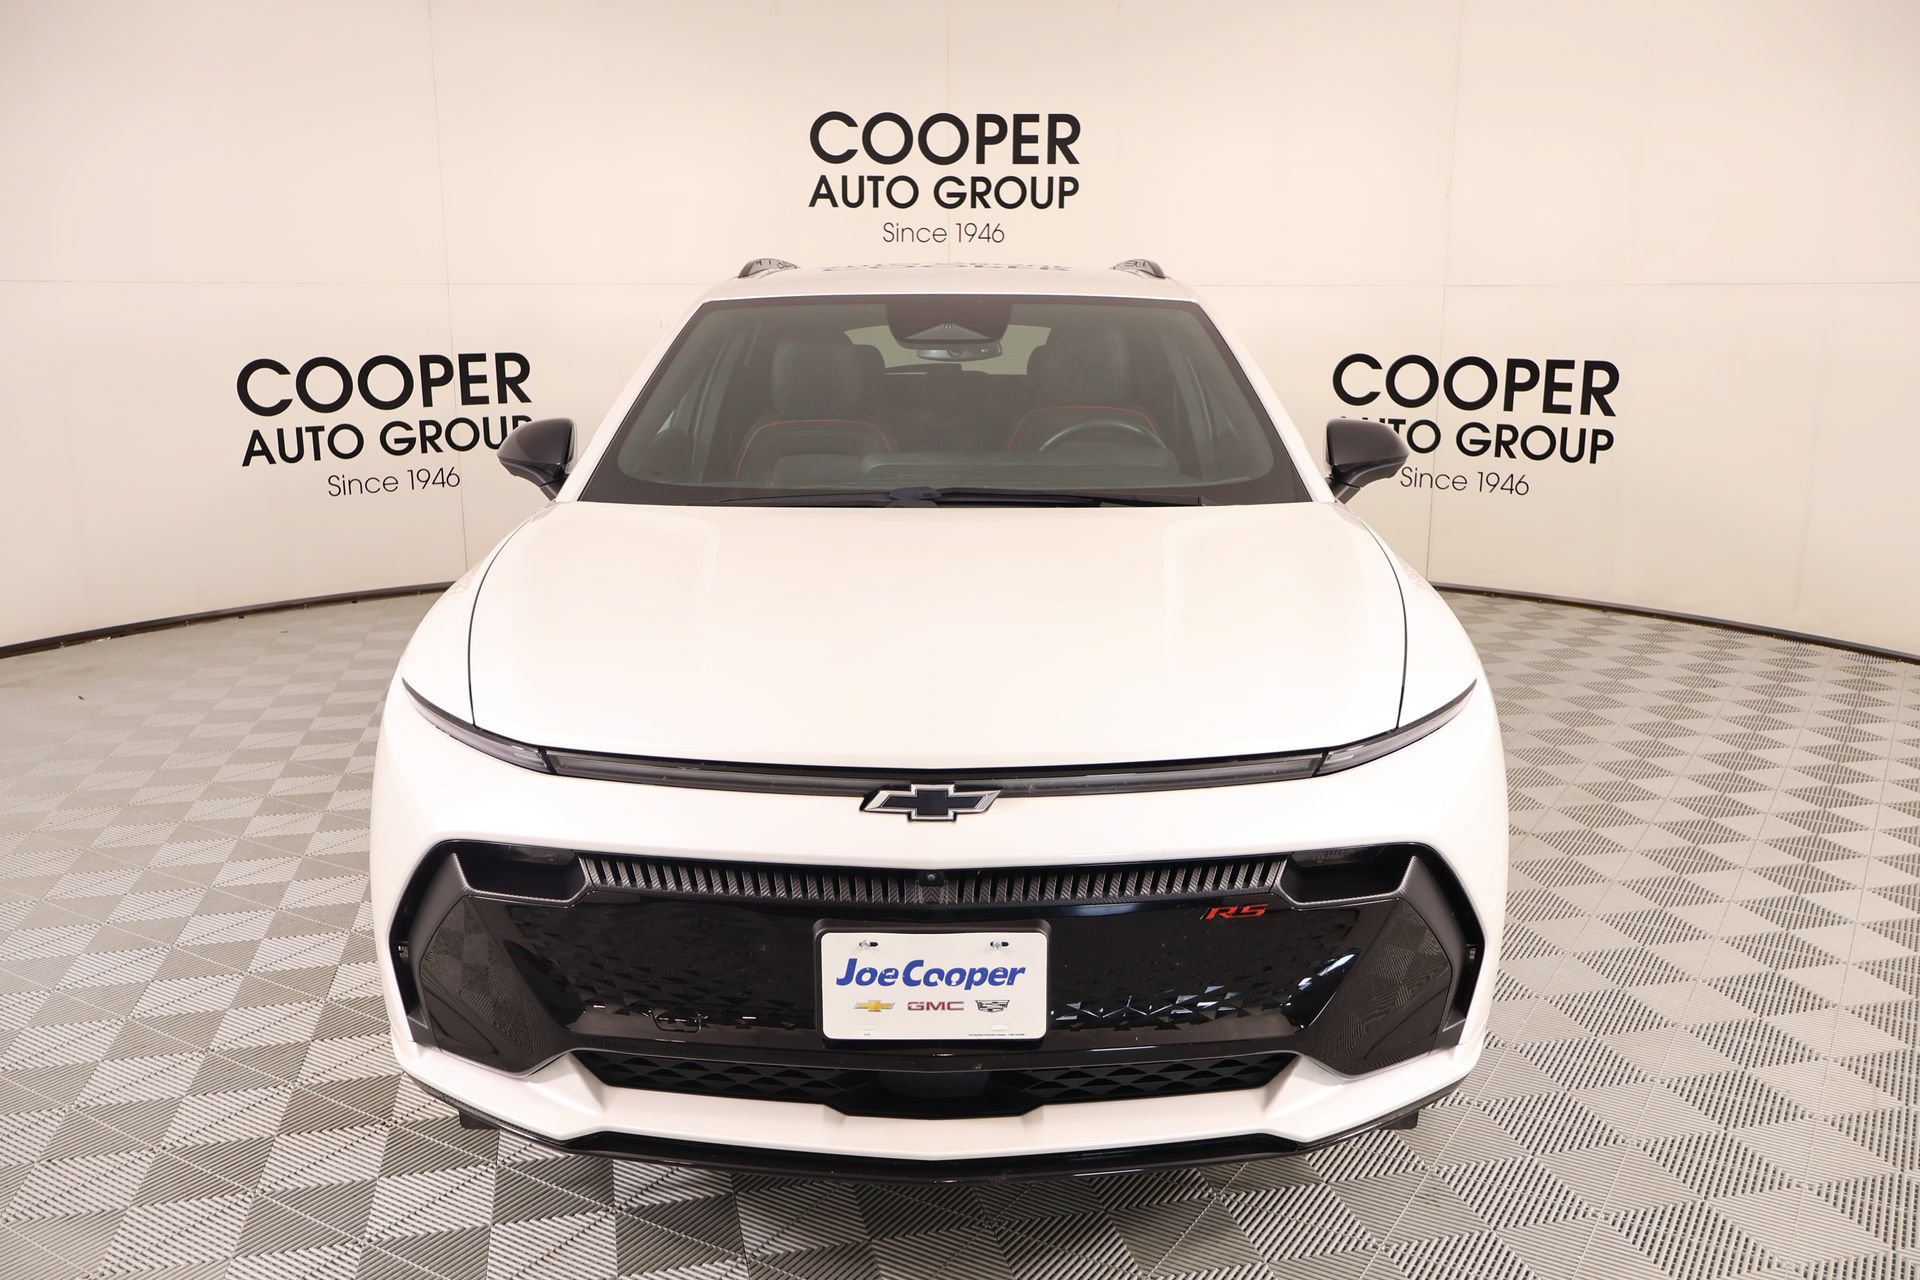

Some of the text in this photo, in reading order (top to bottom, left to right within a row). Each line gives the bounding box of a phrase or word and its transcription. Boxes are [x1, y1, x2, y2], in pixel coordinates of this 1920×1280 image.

[809, 110, 1081, 166] COOPER
[808, 174, 1080, 209] AUTO GROUP
[882, 221, 1005, 244] Since 1946
[236, 351, 532, 418] COOPER
[1332, 352, 1620, 417] COOPER
[242, 422, 365, 468] AUTO
[1456, 421, 1615, 465] GROUP
[327, 466, 461, 497] Since 1946
[1400, 466, 1530, 496] Since 1946
[1204, 904, 1268, 920] RS
[836, 957, 1026, 991] Joe Cooper
[907, 1001, 964, 1011] GMC
